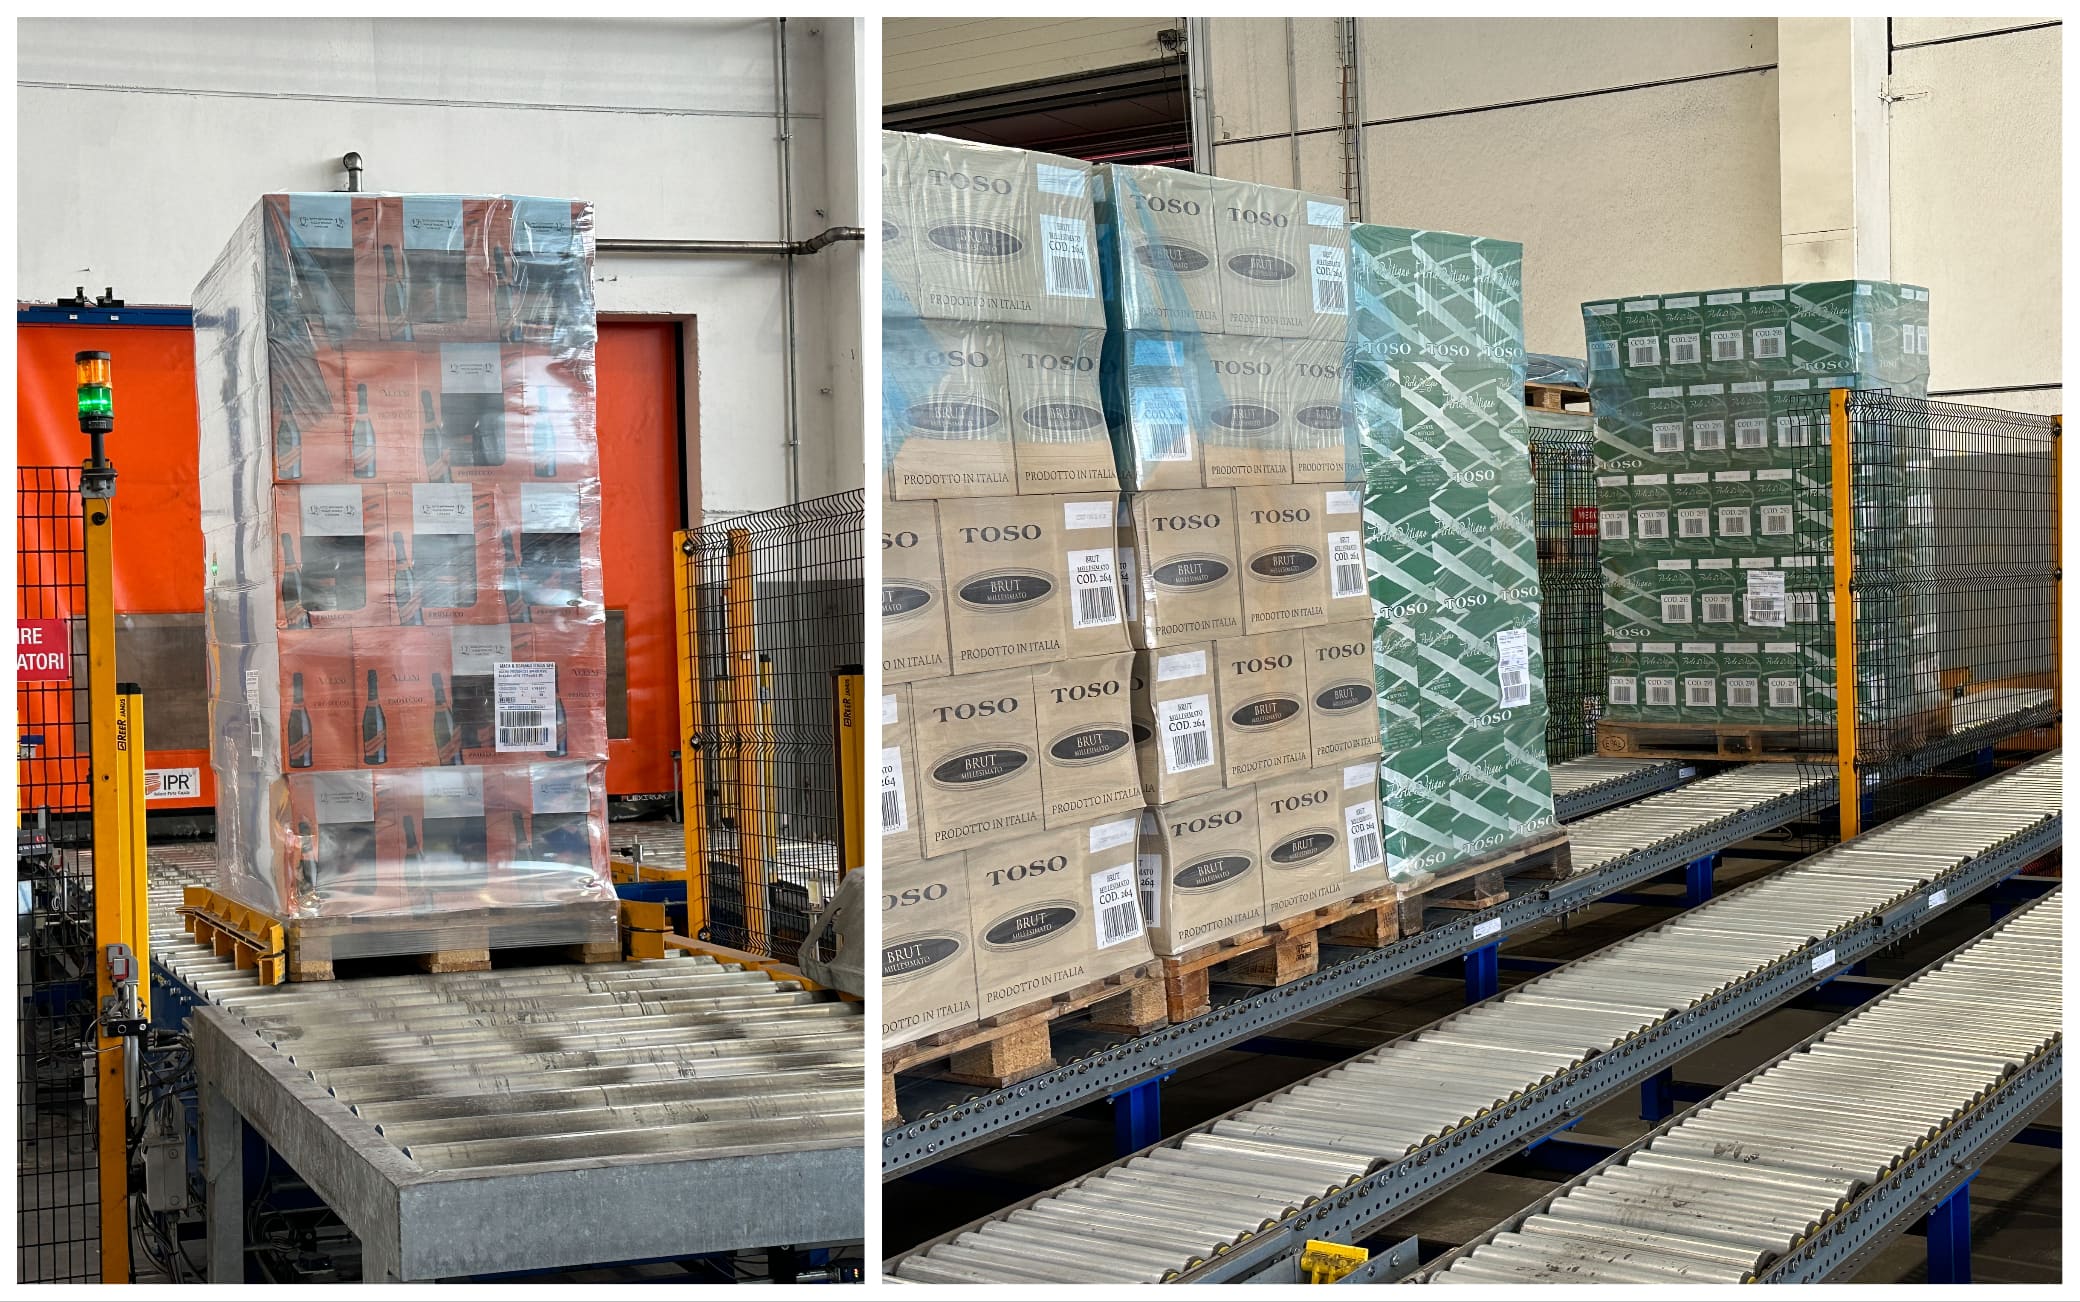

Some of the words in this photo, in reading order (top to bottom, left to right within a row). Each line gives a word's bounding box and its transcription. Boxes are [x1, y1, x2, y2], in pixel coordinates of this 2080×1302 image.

[928, 169, 1012, 195] TOSO
[1129, 194, 1201, 215] TOSO
[1228, 208, 1289, 228] TOSO
[959, 229, 991, 243] BRUT
[1250, 257, 1273, 270] BRUT
[1363, 342, 1412, 355] TOSO
[1426, 343, 1470, 357] TOSO
[1484, 344, 1523, 358] TOSO
[1021, 353, 1094, 372] TOSO
[1210, 359, 1272, 376] TOSO
[1025, 470, 1075, 482] PRODOTTO
[1077, 470, 1087, 479] IN
[1088, 469, 1117, 480] ITALIA
[1211, 465, 1253, 475] PRODOTTO
[1253, 465, 1262, 474] IN
[1263, 464, 1287, 474] ITALIA
[1453, 469, 1495, 483] TOSO
[904, 472, 961, 485] PRODOTTO
[963, 473, 974, 484] IN
[974, 472, 1009, 484] ITALIA
[1152, 513, 1221, 532] TOSO
[1251, 508, 1311, 525] TOSO
[959, 524, 1042, 544] TOSO
[1085, 554, 1100, 564] BRUT
[1273, 554, 1297, 567] BRUT
[1177, 563, 1203, 576] BRUT
[989, 578, 1022, 594] BRUT
[1076, 573, 1099, 585] COD.
[1099, 572, 1112, 584] 264
[1501, 585, 1539, 601] TOSO
[1380, 602, 1428, 620] TOSO
[1445, 594, 1488, 611] TOSO
[1251, 611, 1291, 623] PRODOTTO
[1291, 609, 1300, 618] IN
[1300, 606, 1324, 618] ITALIA
[1156, 622, 1200, 636] PRODOTTO
[1201, 622, 1211, 631] IN
[1211, 616, 1237, 629] ITALIA
[960, 644, 1015, 661] PRODOTTO
[1016, 643, 1027, 654] IN
[1029, 640, 1061, 652] ITALIA
[1315, 642, 1366, 662] TOSO
[17, 652, 64, 671] ATORI
[894, 657, 906, 669] IN
[906, 653, 943, 668] ITALIA
[1231, 654, 1293, 675] TOSO
[1051, 680, 1120, 704] TOSO
[1334, 687, 1354, 700] BRUT
[933, 697, 1018, 723] TOSO
[1177, 702, 1193, 712] BRUT
[1254, 702, 1278, 715] BRUT
[1168, 721, 1192, 733] COD.
[1192, 719, 1206, 729] 264
[1471, 710, 1513, 729] TOSO
[1077, 733, 1103, 747] BRUT
[965, 754, 997, 770] BRUT
[1231, 760, 1272, 775] PRODOTTO
[1273, 757, 1282, 767] IN
[1282, 752, 1307, 765] ITALIA
[961, 766, 1003, 780] MILLESIMATO
[163, 774, 190, 791] IPR
[1051, 796, 1102, 815] PRODOTTO
[1103, 793, 1113, 804] IN
[1113, 787, 1143, 802] ITALIA
[1271, 789, 1329, 814] TOSO
[935, 821, 990, 842] PRODOTTO
[992, 819, 1003, 831] IN
[1004, 811, 1038, 828] ITALIA
[1171, 810, 1243, 837] TOSO
[1518, 815, 1555, 834] TOSO
[1292, 837, 1314, 851] BRUT
[1464, 833, 1504, 853] TOSO
[986, 855, 1068, 886] TOSO
[1198, 860, 1224, 876] BRUT
[1106, 872, 1120, 883] BRUT
[1099, 891, 1120, 905] COD.
[1120, 888, 1133, 899] 264
[1271, 894, 1309, 913] PRODOTTO
[1309, 892, 1317, 901] IN
[1317, 883, 1341, 898] ITALIA
[1015, 912, 1048, 930] BRUT
[1178, 921, 1223, 940] PRODOTTO
[1224, 918, 1234, 928] IN
[1234, 908, 1260, 923] ITALIA
[1012, 923, 1053, 940] MILLESIMATO
[887, 945, 923, 963] BRUT
[884, 956, 931, 974] MILLESIMATO
[987, 979, 1040, 1003] PRODOTTO
[1041, 975, 1052, 986] IN
[1053, 965, 1085, 982] ITALIA
[922, 1012, 935, 1023] IN
[936, 1000, 971, 1017] ITALIA
